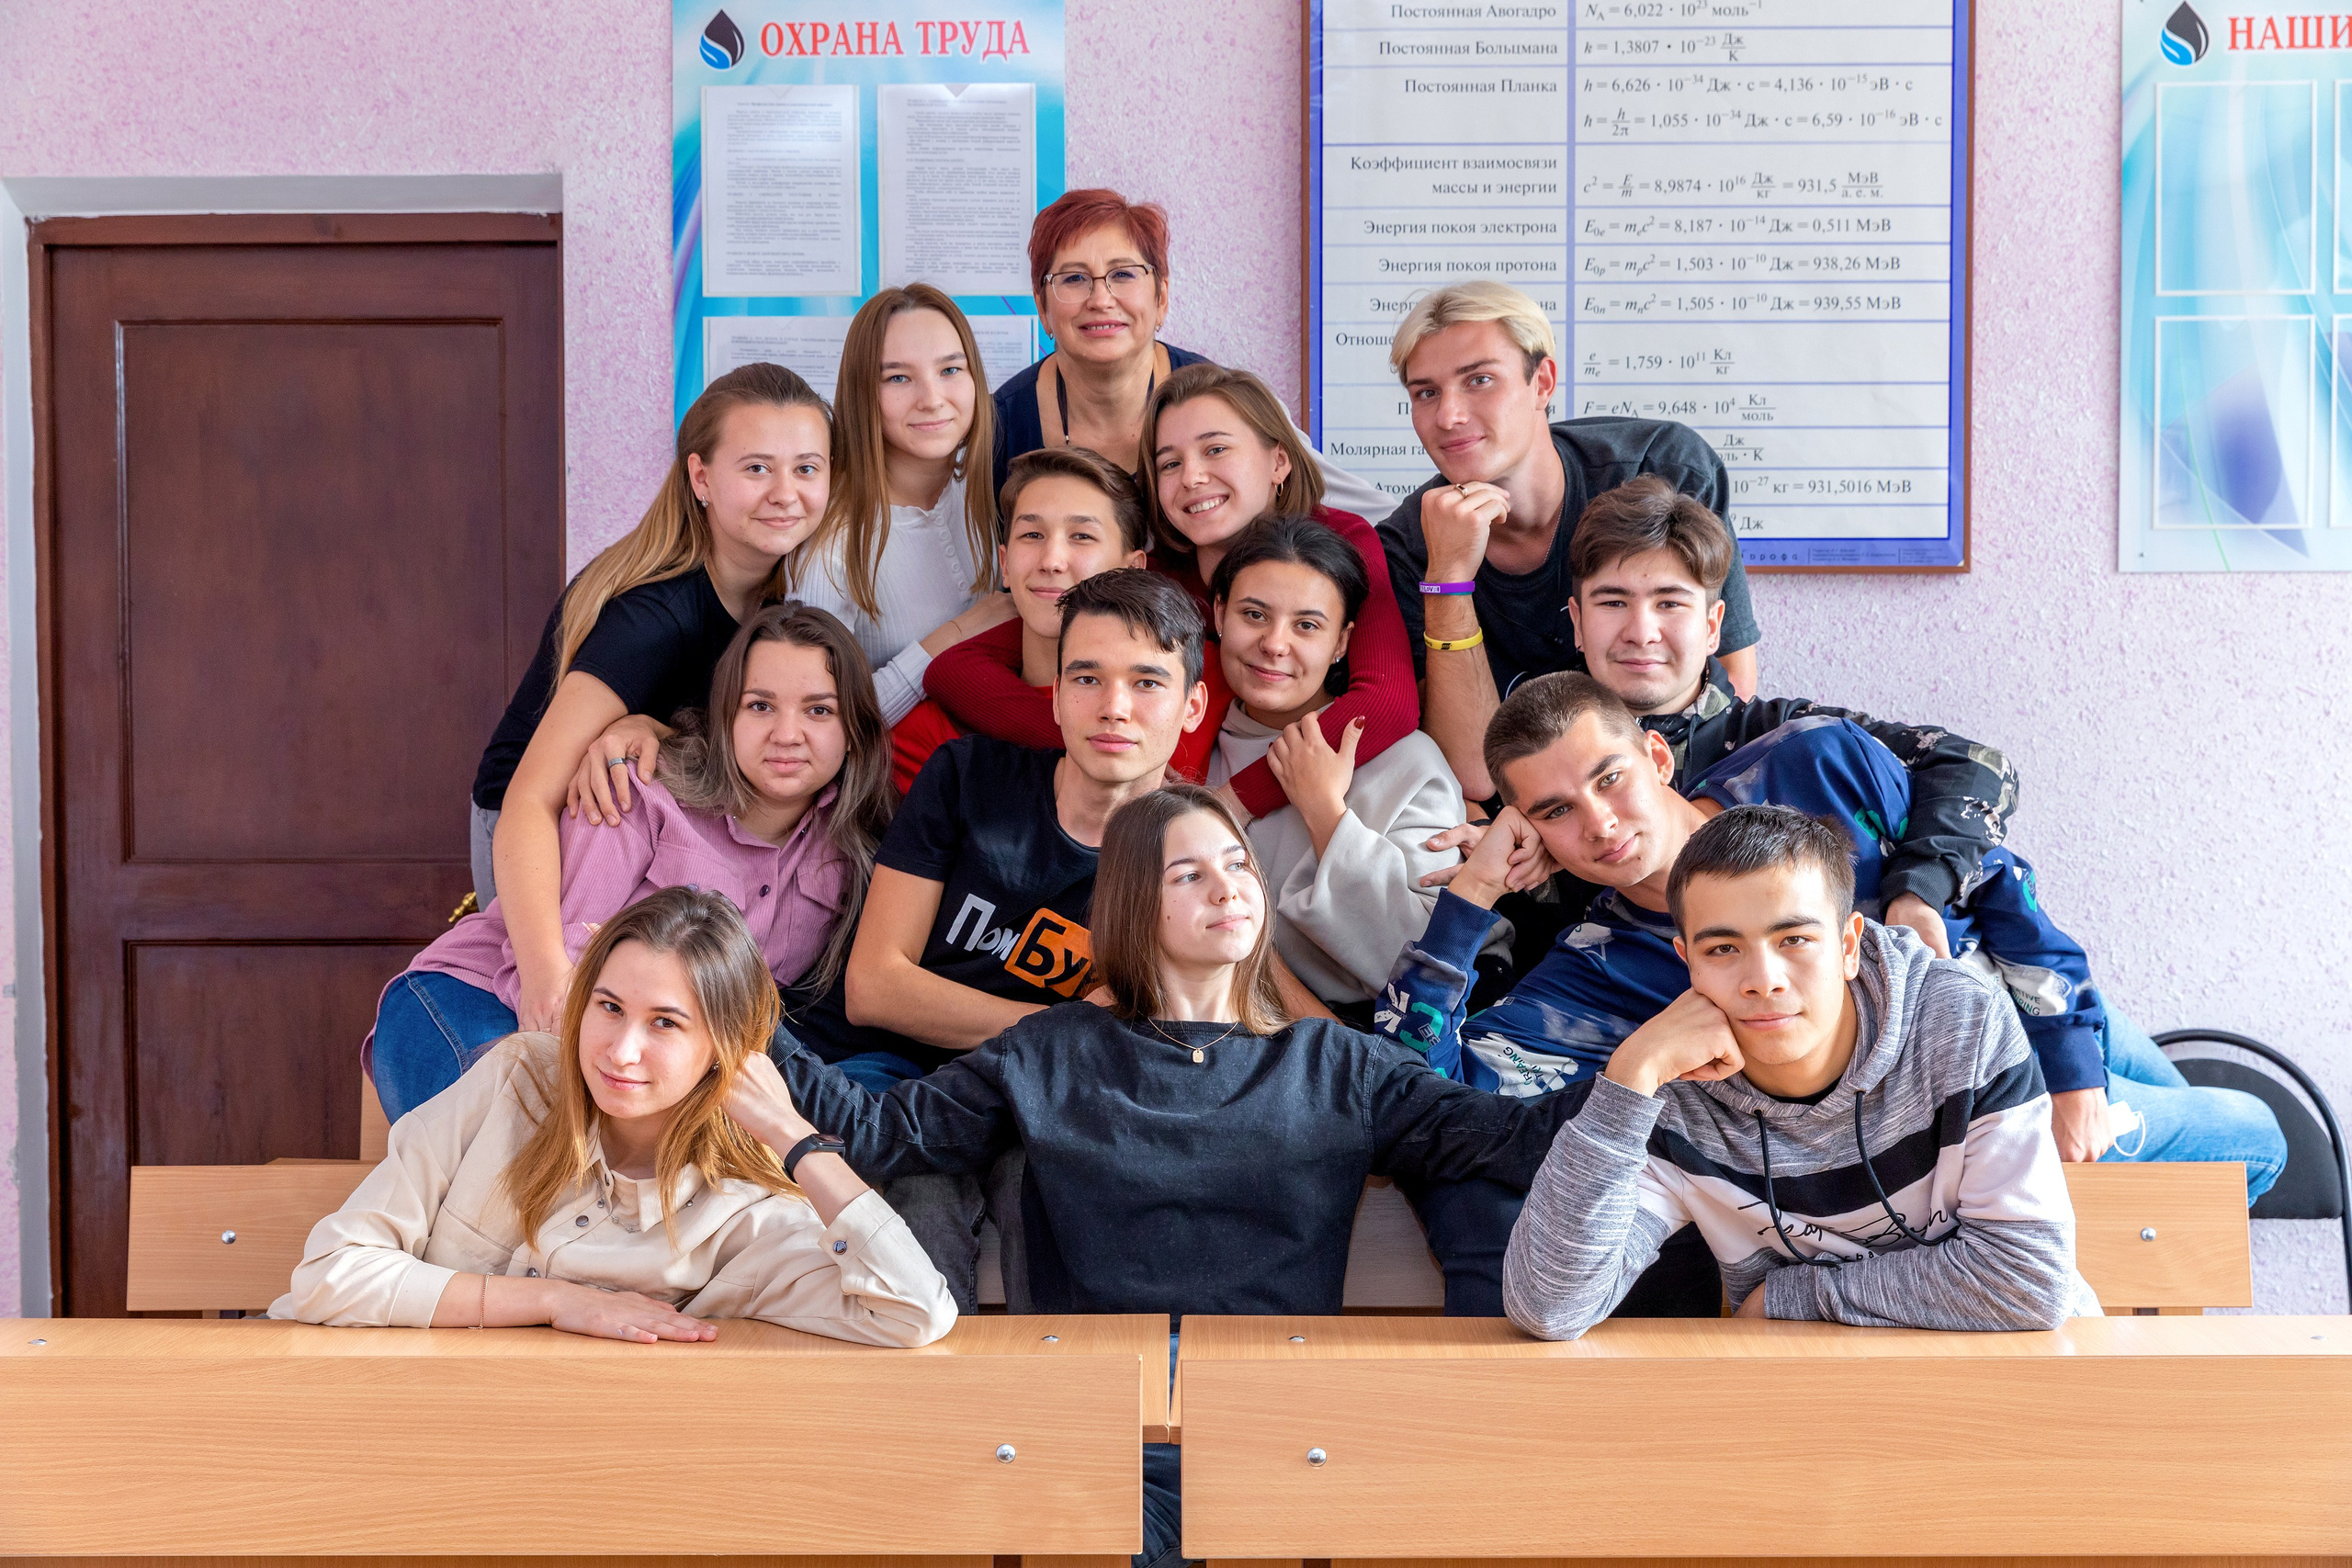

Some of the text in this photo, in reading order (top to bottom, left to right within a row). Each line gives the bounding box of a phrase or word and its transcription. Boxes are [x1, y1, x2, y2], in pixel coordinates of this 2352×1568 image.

[1392, 5, 1555, 19] Постоянная Авогадро
[1624, 4, 1662, 17] 6,022
[761, 19, 1031, 62] ОХРАНА ТРУДА
[1615, 40, 1658, 54] 1,3807
[1721, 32, 1744, 47] Дж
[1380, 41, 1557, 54] Постоянная Больцмана
[1406, 79, 1556, 92] Постоянная Планка
[1584, 79, 1592, 92] h
[1612, 79, 1650, 93] 6,626
[1707, 79, 1730, 92] Дж
[1775, 78, 1813, 92] 4,136
[1871, 78, 1889, 91] эВ
[1616, 107, 1625, 120] h
[1653, 114, 1688, 128] 1,055
[1745, 114, 1768, 128] Дж
[1813, 113, 1842, 127] 6,59
[1900, 113, 1918, 127] эВ
[1351, 156, 1556, 173] Коэффициент взаимосвязи
[1623, 174, 1633, 186] E
[1751, 172, 1773, 185] Дж
[1848, 171, 1879, 184] МэВ
[1433, 184, 1556, 196] массы и энергии
[1655, 179, 1701, 194] 8,9874
[1798, 179, 1836, 193] 931,5
[1621, 189, 1632, 197] m
[1364, 221, 1556, 236] Энергия покоя электрона
[1675, 220, 1712, 233] 8,187
[1769, 220, 1792, 232] Дж
[1813, 219, 1849, 232] 0,511
[1857, 219, 1891, 231] МэВ
[1379, 259, 1556, 274] Энергия покоя протона
[1678, 257, 1713, 271] 1,503
[1770, 257, 1792, 271] Дж
[1814, 257, 1860, 271] 938,26
[1866, 257, 1900, 269] МэВ
[1679, 298, 1713, 310] 1,505
[1770, 298, 1793, 310] Дж
[1815, 297, 1860, 310] 939,55
[1867, 297, 1901, 309] МэВ
[1713, 348, 1732, 361] Кл
[1627, 355, 1662, 370] 1,759
[1715, 366, 1730, 375] кг
[1748, 394, 1767, 406] Кл
[1658, 401, 1696, 414] 9,648
[1741, 412, 1774, 422] моль
[1724, 434, 1745, 447] Дж
[1331, 443, 1406, 457] Молярная
[1774, 484, 1788, 492] кг
[1808, 480, 1871, 494] 931,5016
[1878, 480, 1911, 492] МэВ
[1740, 517, 1763, 530] Дж
